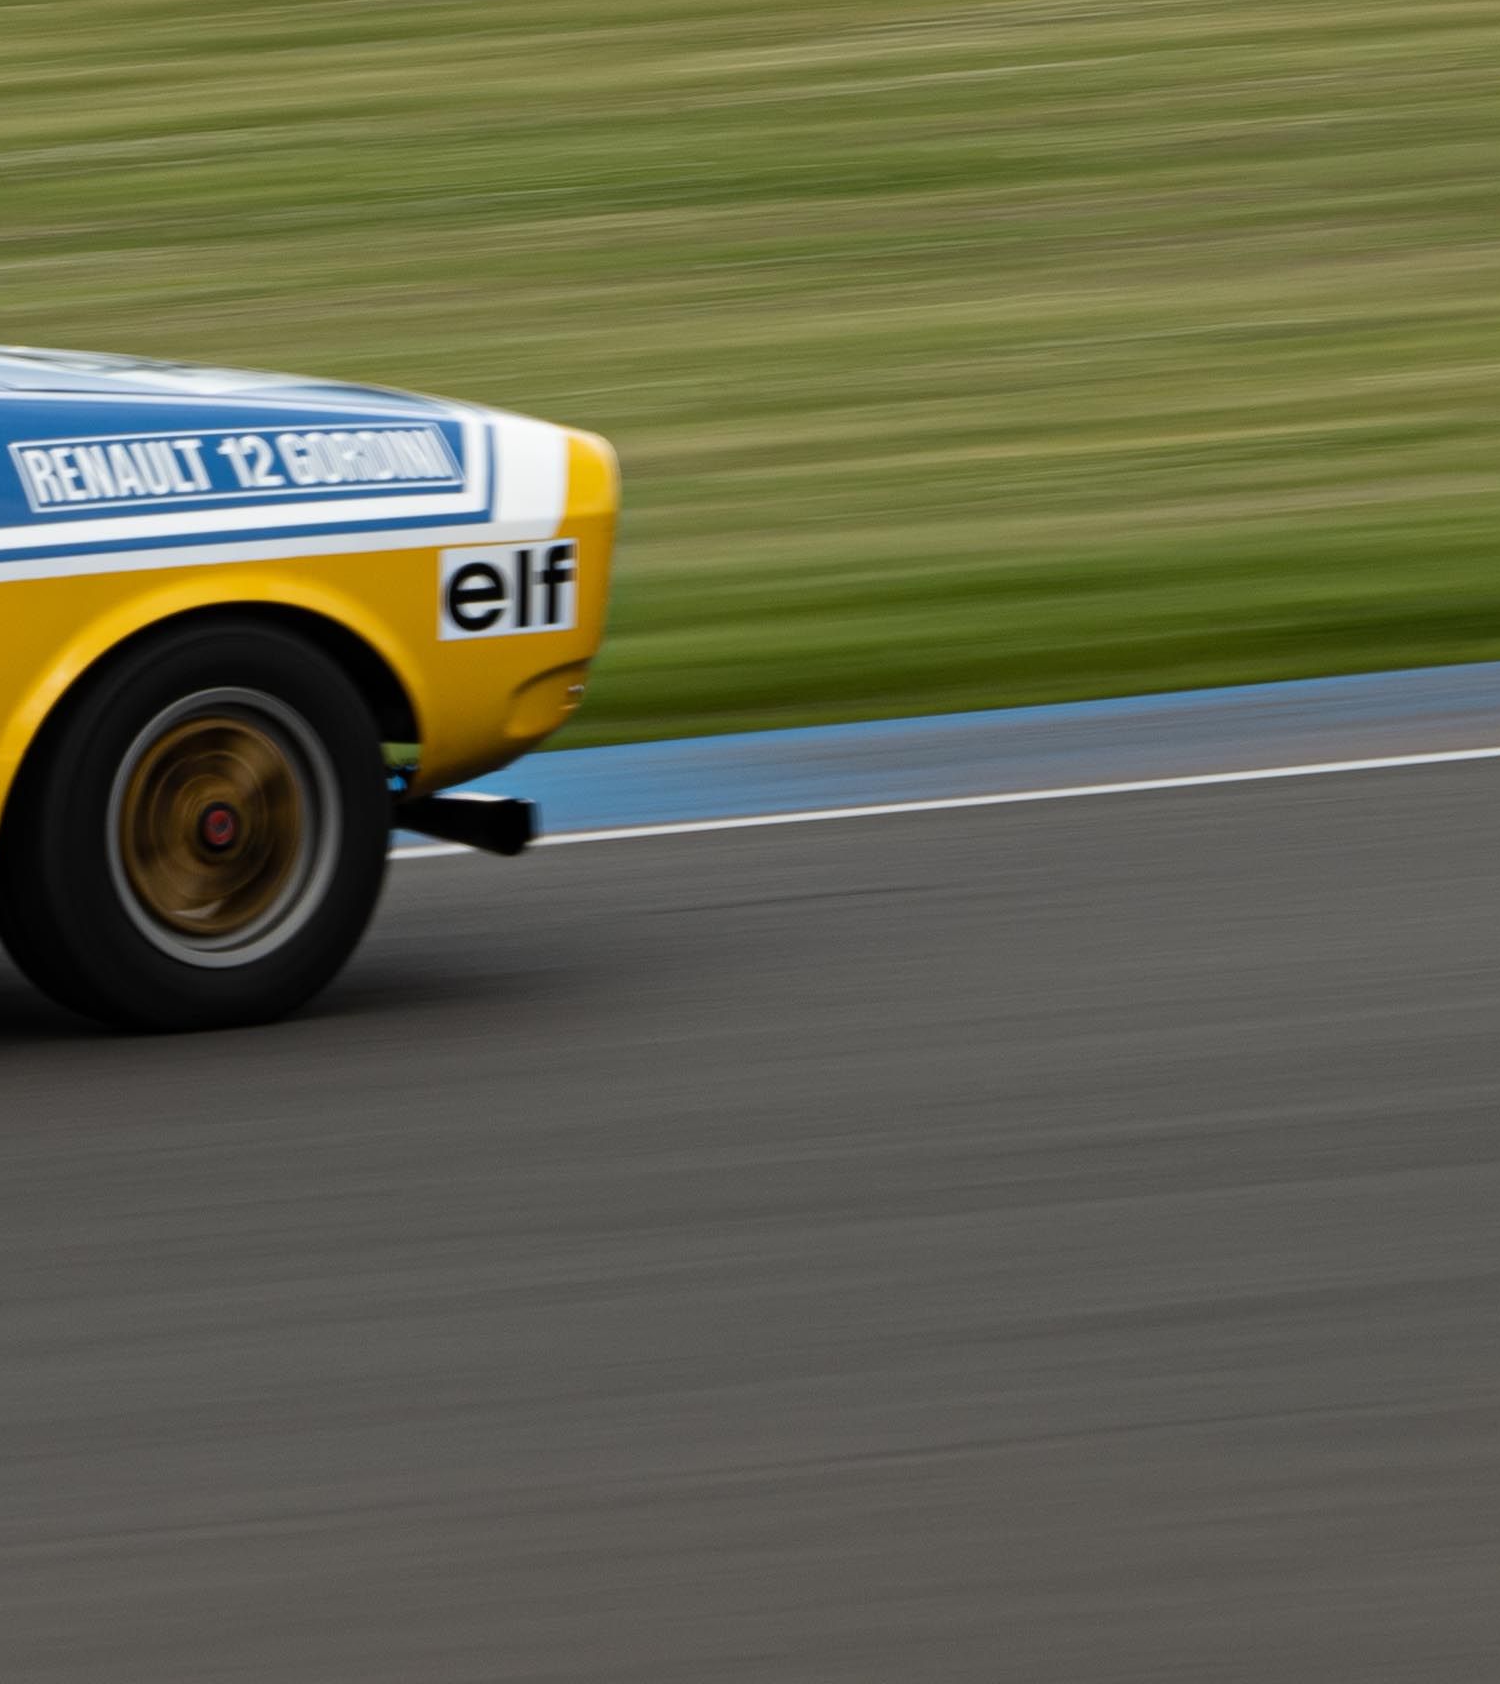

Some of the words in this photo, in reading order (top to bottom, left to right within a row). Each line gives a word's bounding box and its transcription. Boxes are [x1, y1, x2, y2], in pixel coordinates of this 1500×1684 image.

[22, 439, 212, 504] RENAULT
[218, 435, 288, 488] 12
[447, 544, 576, 632] elf
